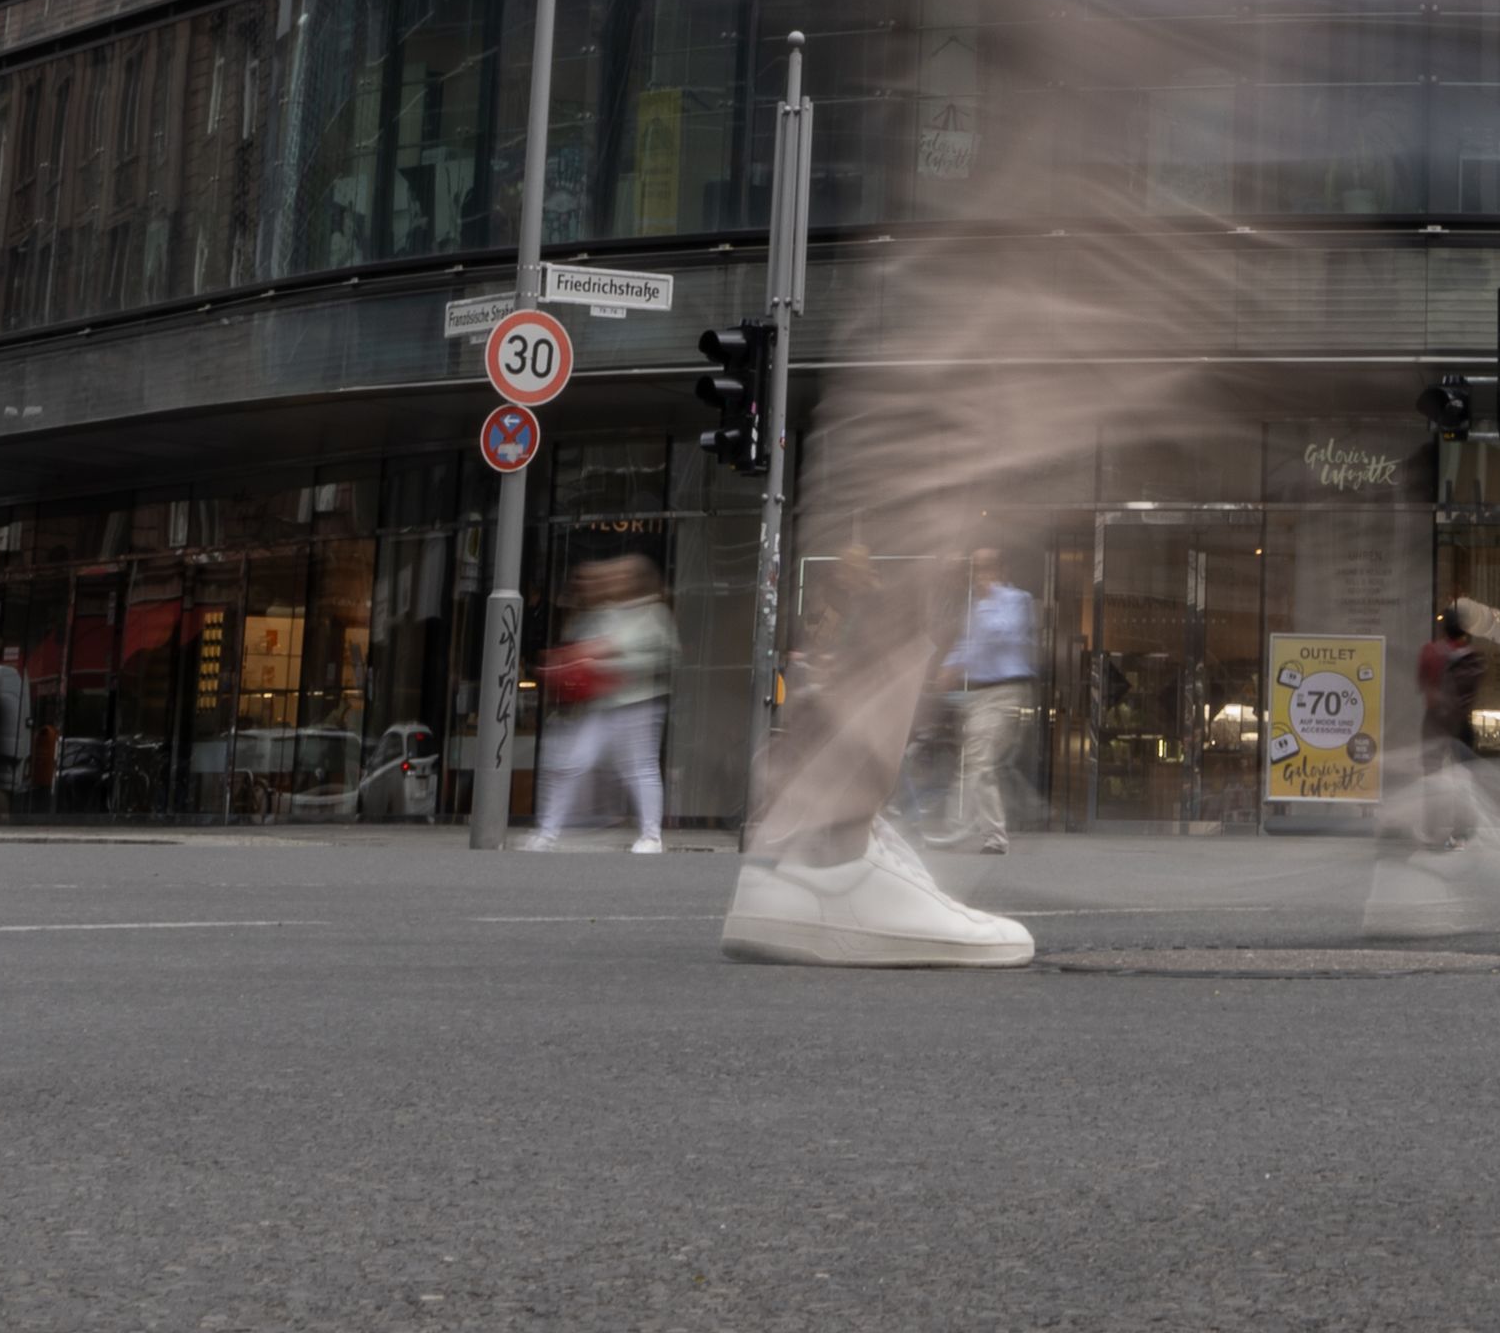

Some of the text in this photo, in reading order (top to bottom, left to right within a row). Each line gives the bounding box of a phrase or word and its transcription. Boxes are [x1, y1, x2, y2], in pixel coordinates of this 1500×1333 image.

[557, 274, 660, 302] Friedrichstraße
[505, 334, 554, 379] 30
[1300, 647, 1356, 661] OUTLET
